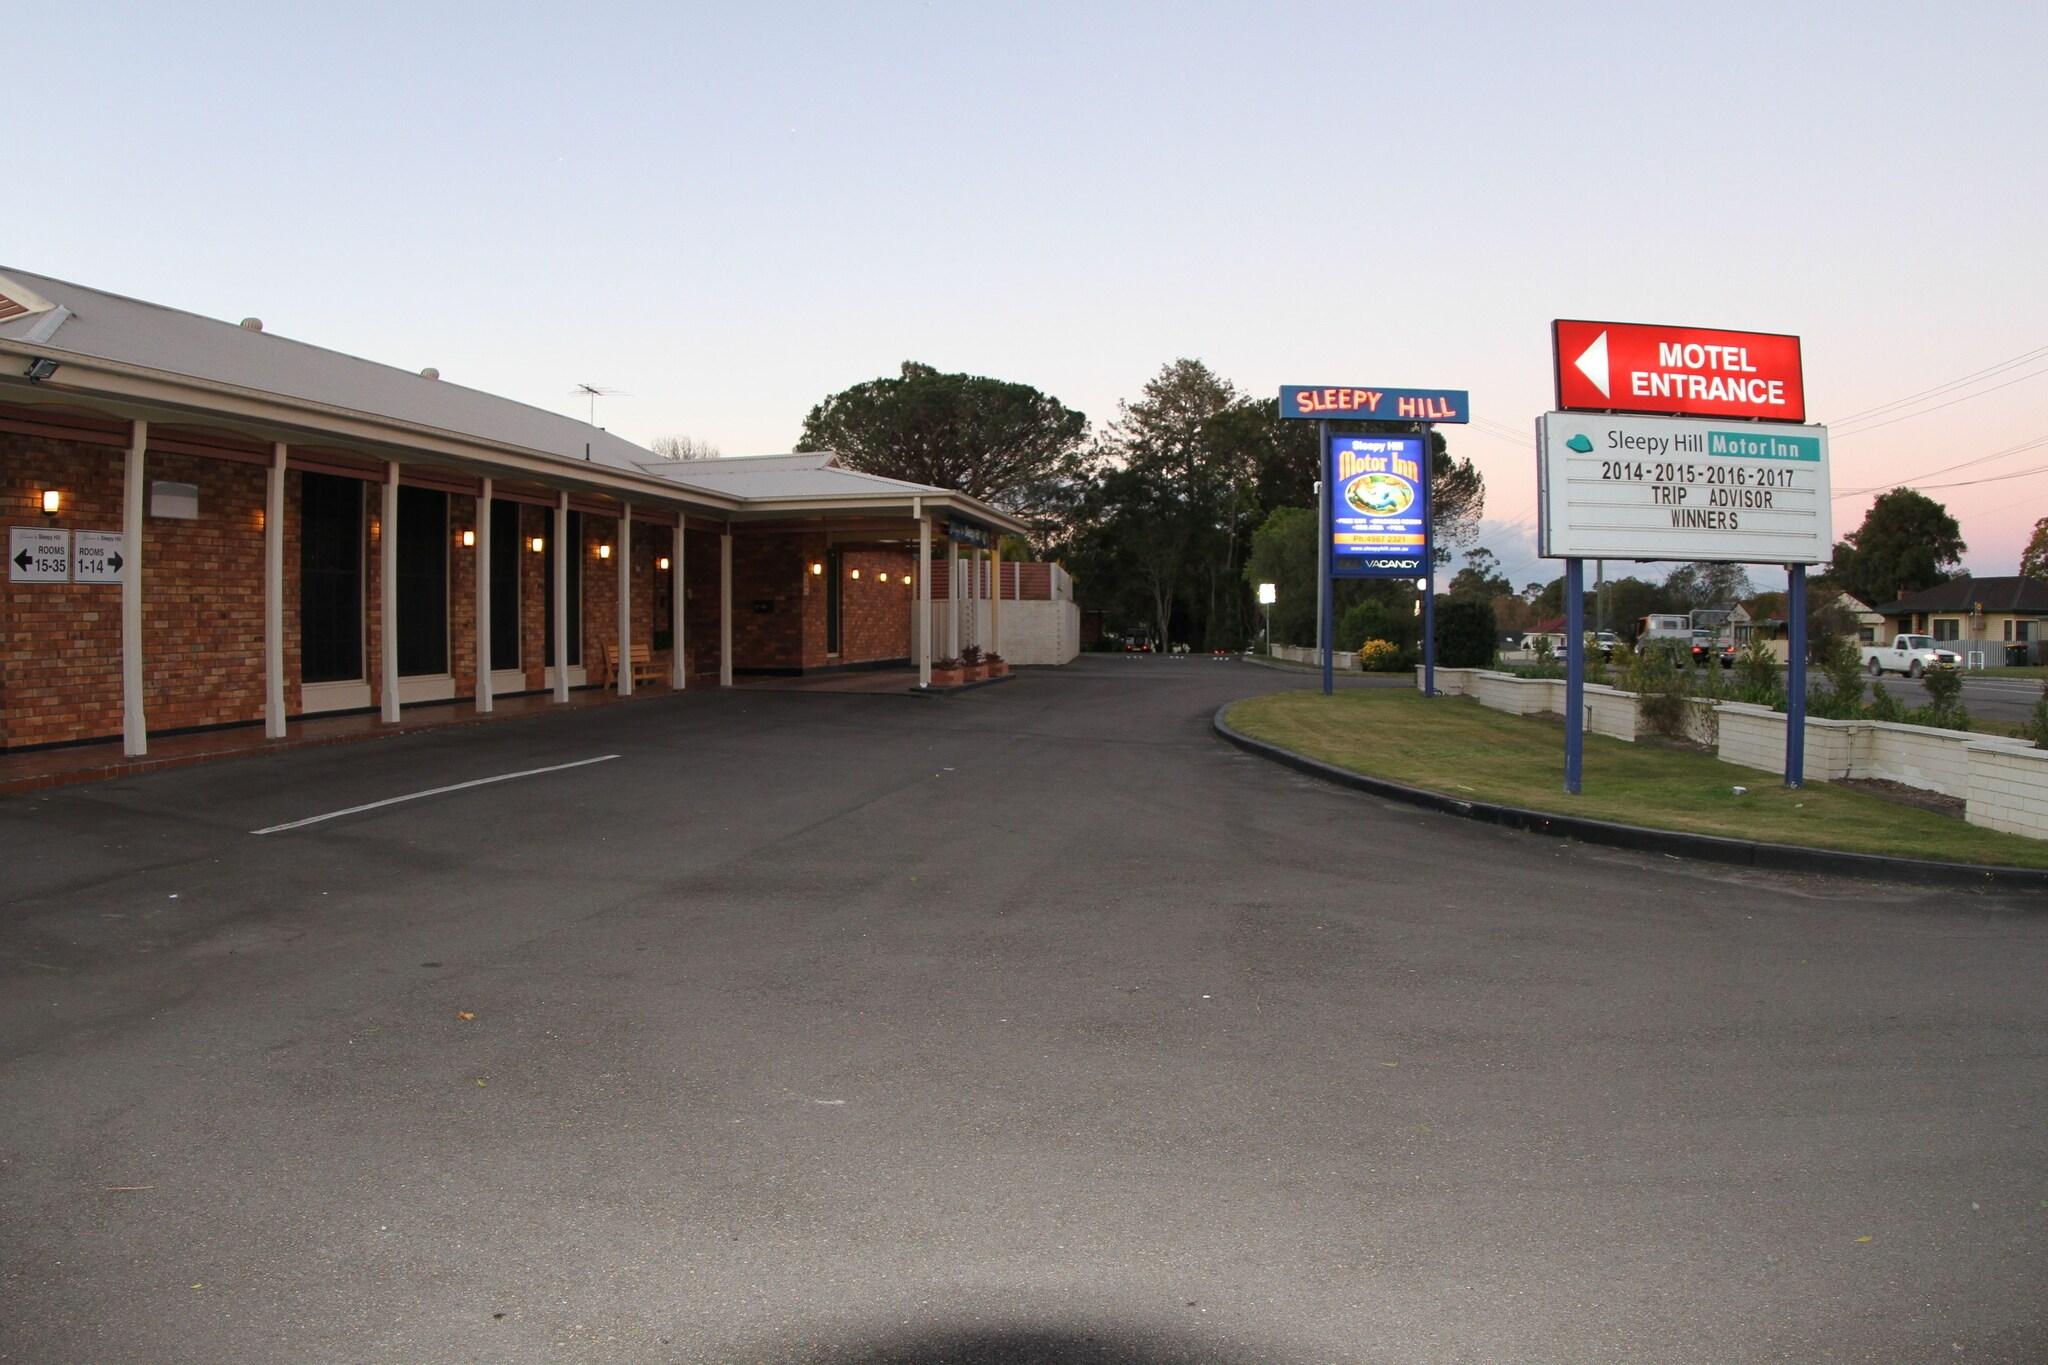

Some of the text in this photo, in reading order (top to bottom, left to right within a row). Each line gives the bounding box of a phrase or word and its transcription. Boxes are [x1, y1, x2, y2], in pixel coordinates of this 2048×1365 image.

[1659, 342, 1757, 372] MOTEL
[1631, 371, 1785, 405] ENTRANCE
[1296, 388, 1457, 418] SLEEPY HILL
[1352, 440, 1385, 453] Sleepy
[1607, 430, 1669, 456] Sleepy
[1675, 434, 1703, 453] Hill
[1339, 451, 1418, 483] Motor Inn
[1602, 461, 1794, 488] 2014-2015-2016-2017
[1651, 486, 1773, 509] TRIP ADVISOR
[1671, 509, 1739, 530] WINNERS
[38, 545, 65, 555] ROOMS
[79, 547, 105, 556] ROOMS
[35, 558, 66, 573] 15-35
[78, 559, 104, 574] 1-14
[1365, 559, 1419, 569] VACANCY
